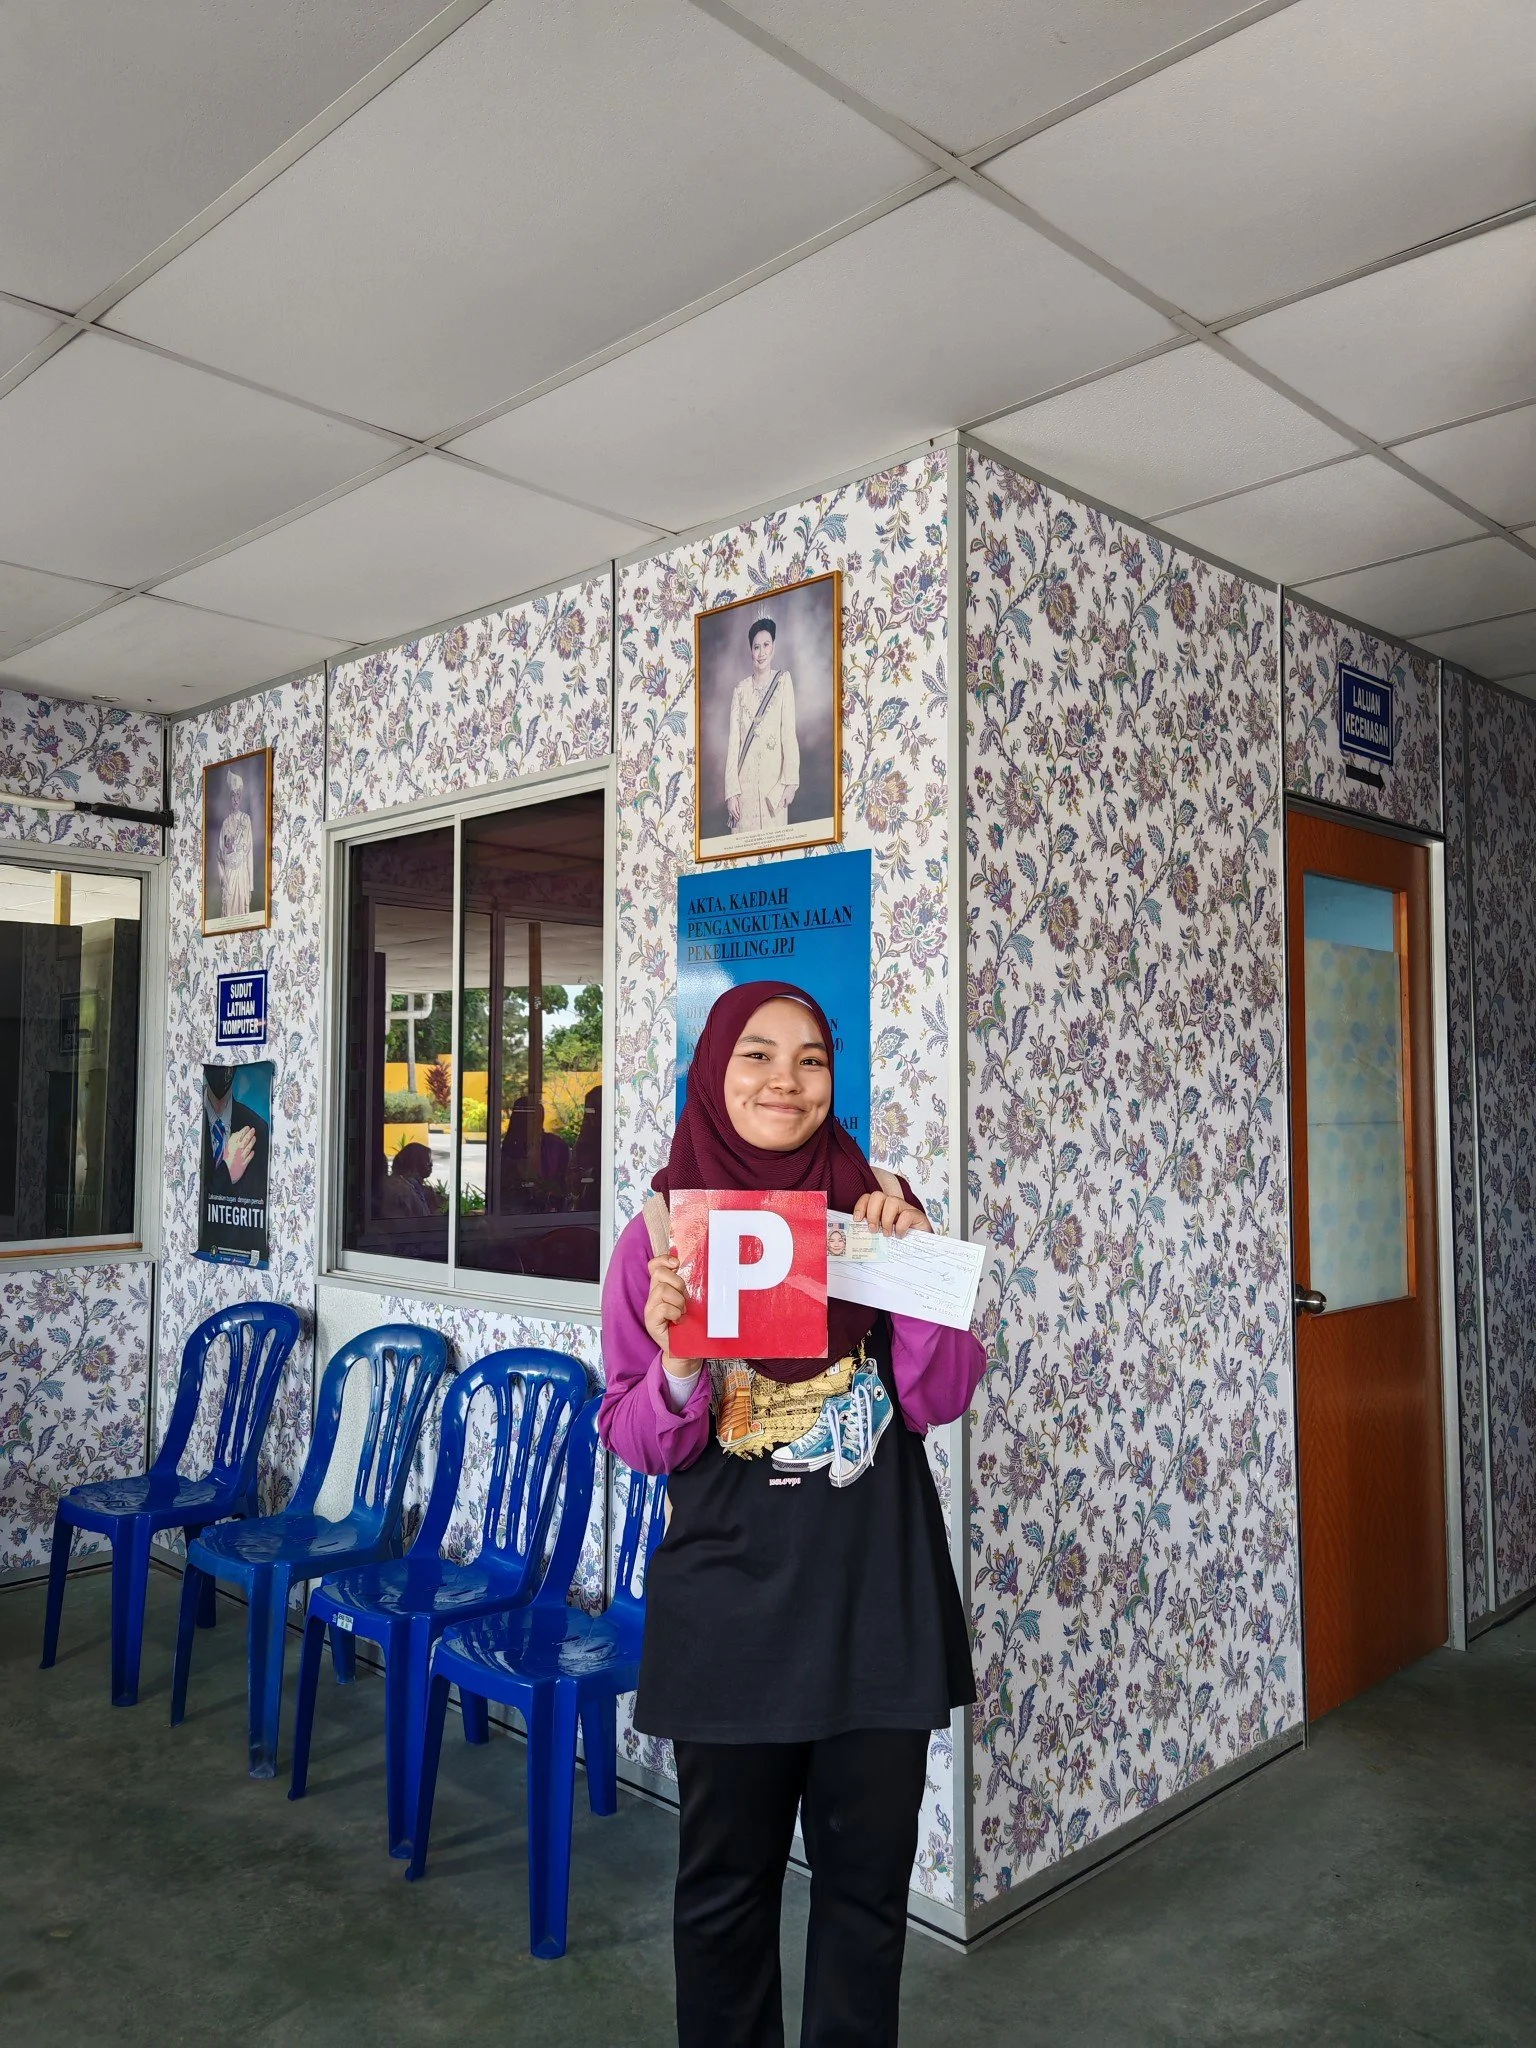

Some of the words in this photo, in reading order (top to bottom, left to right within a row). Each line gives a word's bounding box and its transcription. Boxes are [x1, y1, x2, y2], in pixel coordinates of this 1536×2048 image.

[1353, 686, 1380, 716] LALUAN
[1345, 711, 1389, 748] KECEMASAN
[687, 896, 726, 915] AKTA,
[729, 887, 789, 911] KAEDAH
[687, 911, 801, 939] PENGANGKUTAN
[803, 905, 853, 927] JALAN
[687, 937, 770, 962] PEKELILING
[772, 936, 796, 955] JPJ
[230, 982, 253, 999] SUDUT
[226, 1000, 256, 1017] LATIHAN
[222, 1018, 259, 1036] KOMPUTER
[208, 1204, 264, 1228] INTEGRITI
[707, 1209, 794, 1339] P
